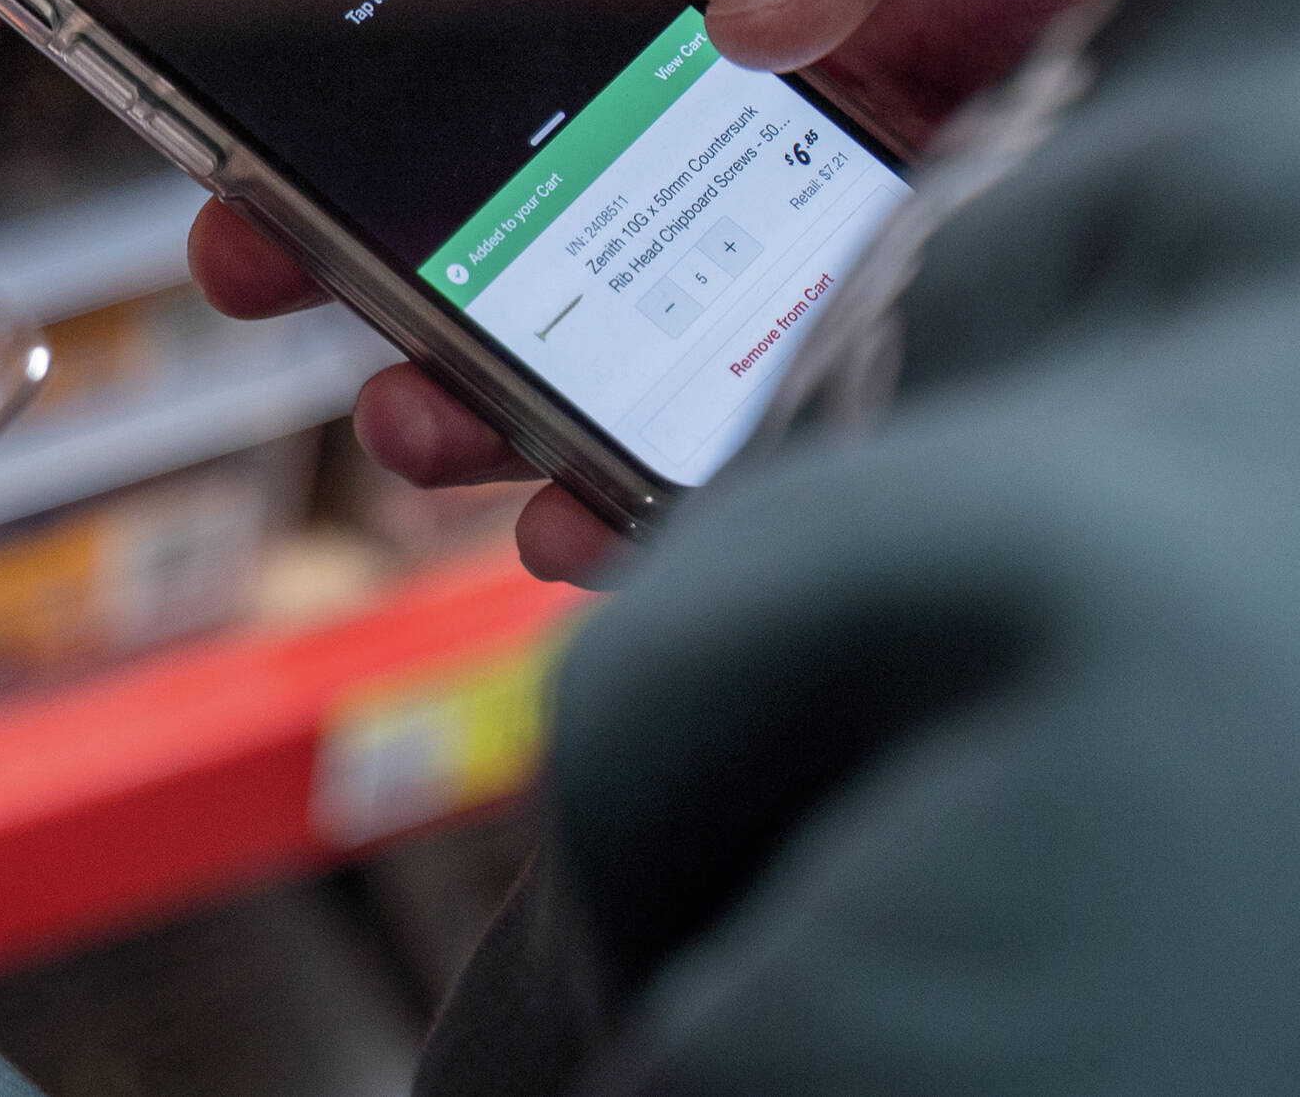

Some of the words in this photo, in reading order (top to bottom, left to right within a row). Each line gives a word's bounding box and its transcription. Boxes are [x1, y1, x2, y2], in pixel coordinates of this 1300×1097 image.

[344, 2, 374, 25] Tap
[653, 55, 682, 82] View
[679, 31, 708, 59] Cart
[784, 128, 819, 167] $6.85
[586, 236, 627, 275] Zenith
[621, 212, 650, 238] 10G
[646, 204, 660, 217] x
[653, 170, 693, 208] 50mm
[688, 105, 760, 173] Countersunk
[608, 272, 634, 294] Rib
[627, 239, 664, 273] Head
[659, 184, 719, 244] Chipboard
[713, 146, 759, 189] Screws
[759, 118, 792, 144] 50...
[789, 178, 825, 211] Retail:
[818, 151, 850, 182] $7.21
[467, 228, 506, 266] Added
[501, 218, 517, 233] to
[514, 195, 539, 224] your
[536, 172, 564, 199] Cart
[565, 233, 589, 256] I/N:
[584, 194, 629, 239] 2408511
[695, 273, 708, 285] 5
[728, 326, 782, 379] Remove
[775, 300, 810, 331] from
[803, 272, 836, 303] Cart
